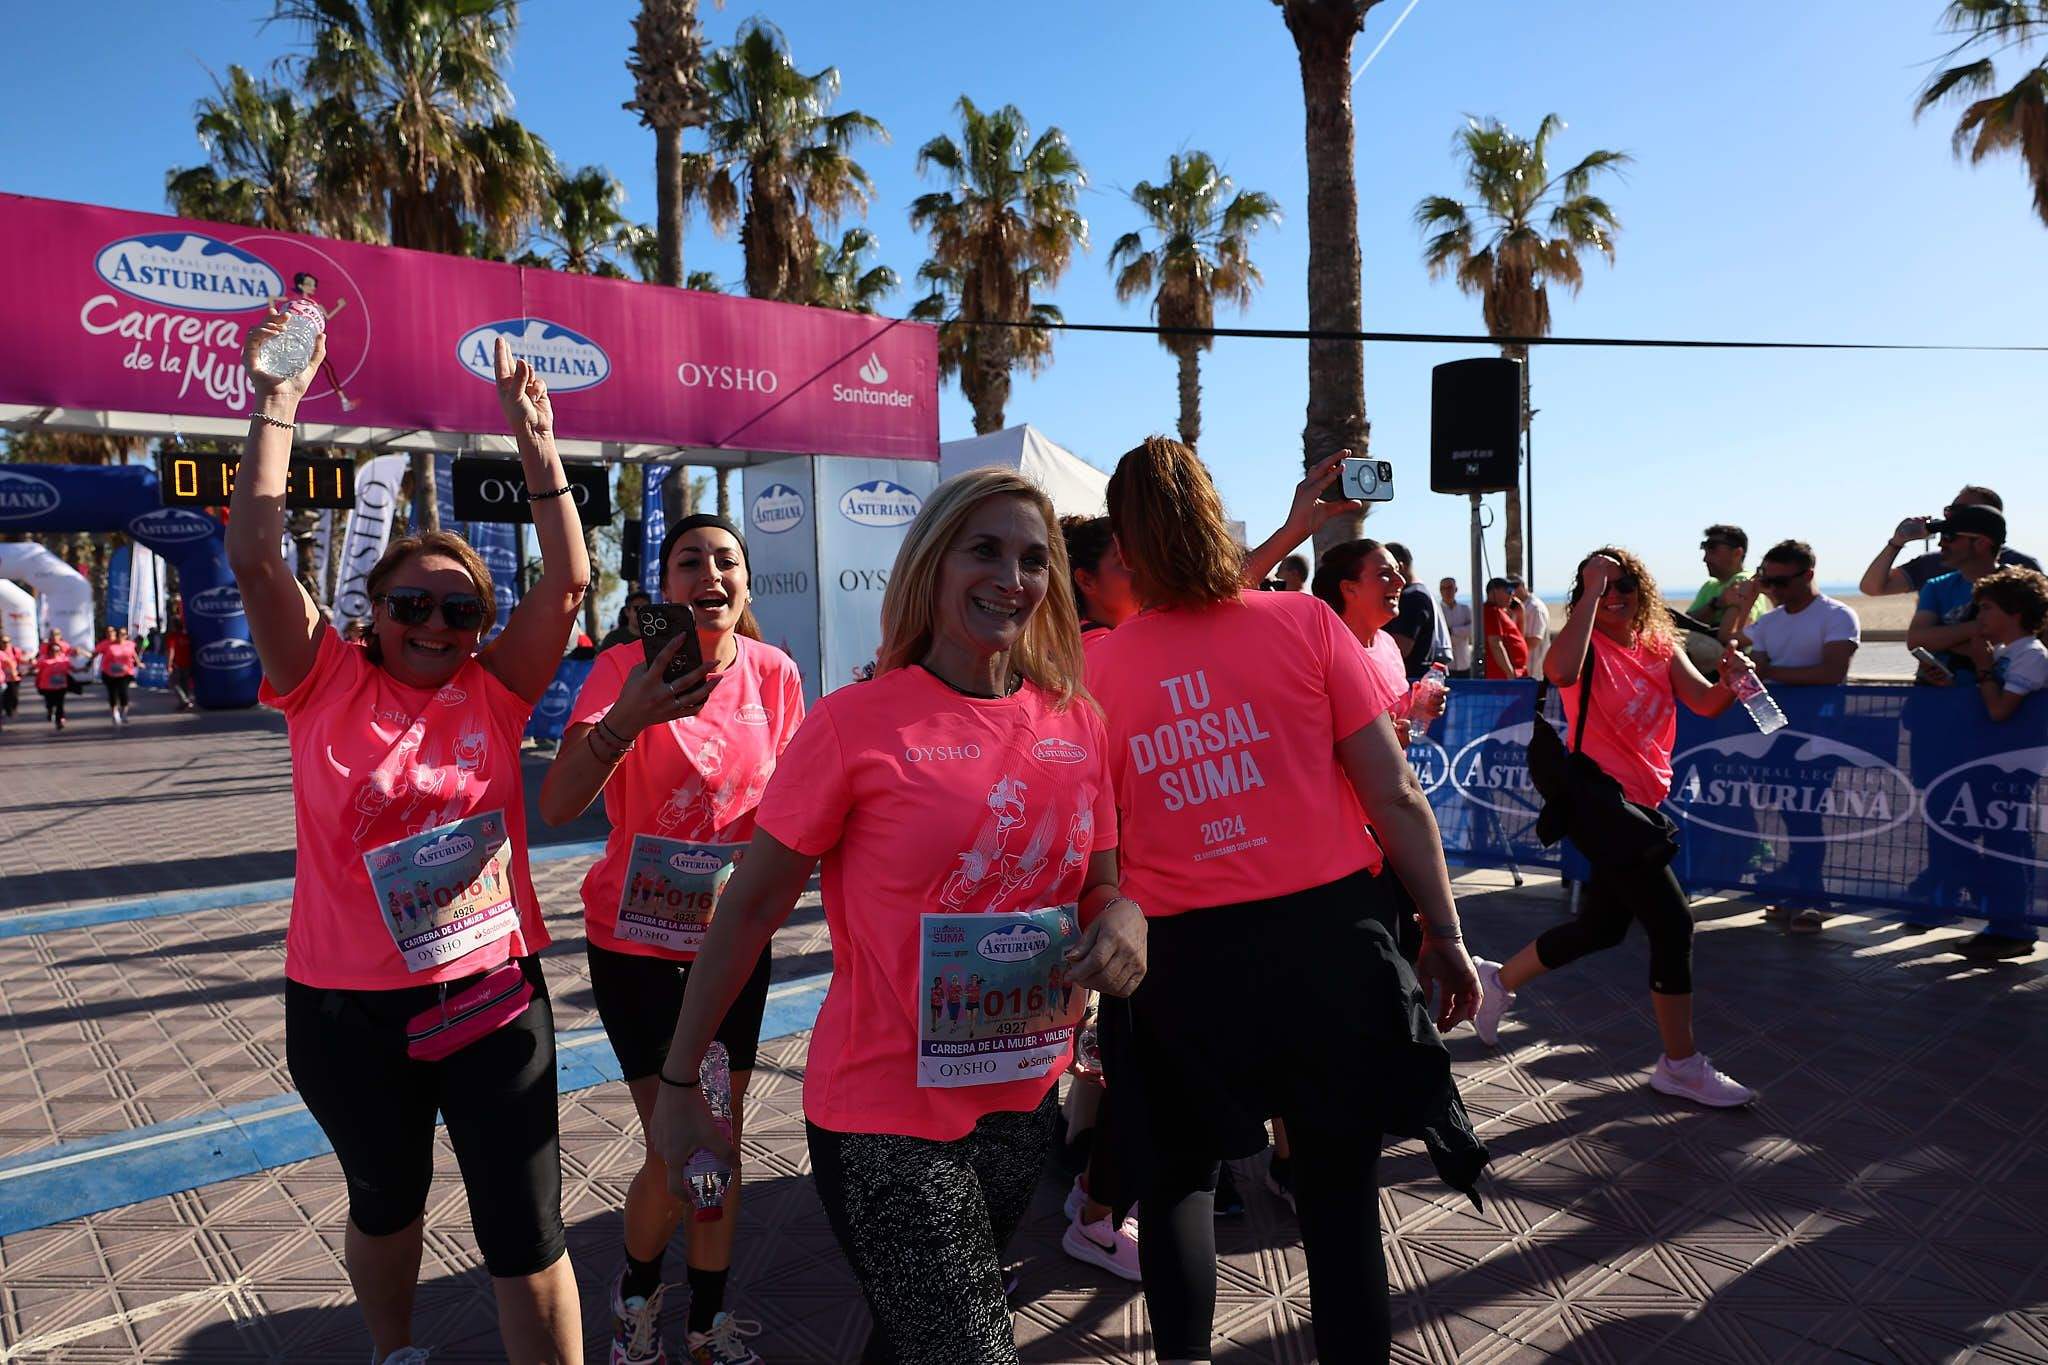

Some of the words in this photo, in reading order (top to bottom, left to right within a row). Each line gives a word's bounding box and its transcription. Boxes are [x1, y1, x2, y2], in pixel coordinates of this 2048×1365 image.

[112, 251, 270, 298] ASTURIANA
[80, 294, 241, 349] Carrera
[123, 345, 154, 371] de
[160, 344, 181, 373] la
[178, 346, 256, 412] Muj
[677, 361, 778, 395] OYSHO
[832, 383, 914, 409] Santander
[754, 505, 801, 524] ASTURIANA
[845, 496, 918, 517] ASTURIANA
[339, 479, 390, 618] OYSHO
[754, 570, 808, 597] OYSHO
[839, 568, 888, 593] OYS
[1160, 669, 1211, 716] TU
[1128, 701, 1271, 775] DORSAL
[905, 744, 981, 763] OYSHO
[1158, 750, 1266, 812] SUMA
[1713, 763, 1792, 778] CENTRAL
[1673, 763, 1894, 821] ASTURIANA
[1200, 814, 1247, 846] 2024
[419, 839, 473, 865] ASTURIANA
[672, 855, 720, 870] ASTURIANA
[433, 880, 484, 909] 016
[666, 888, 714, 911] 016
[453, 904, 476, 920] 4926
[625, 912, 657, 925] CARRERA
[658, 919, 667, 927] DE
[668, 921, 678, 929] LA
[403, 931, 441, 950] CARRERA
[441, 925, 453, 936] DE
[453, 921, 464, 932] LA
[464, 913, 485, 929] MUJER
[628, 926, 670, 941] OYSHO
[933, 934, 965, 944] SUMA
[418, 938, 462, 962] OYSHO
[982, 939, 1046, 955] ASTURIANA
[983, 984, 1044, 1017] 016
[996, 1021, 1027, 1035] 4927
[930, 1042, 976, 1055] CARRERA
[978, 1041, 991, 1052] DE
[992, 1039, 1005, 1050] LA
[1007, 1035, 1038, 1049] MUJER
[940, 1059, 997, 1077] OYSHO
